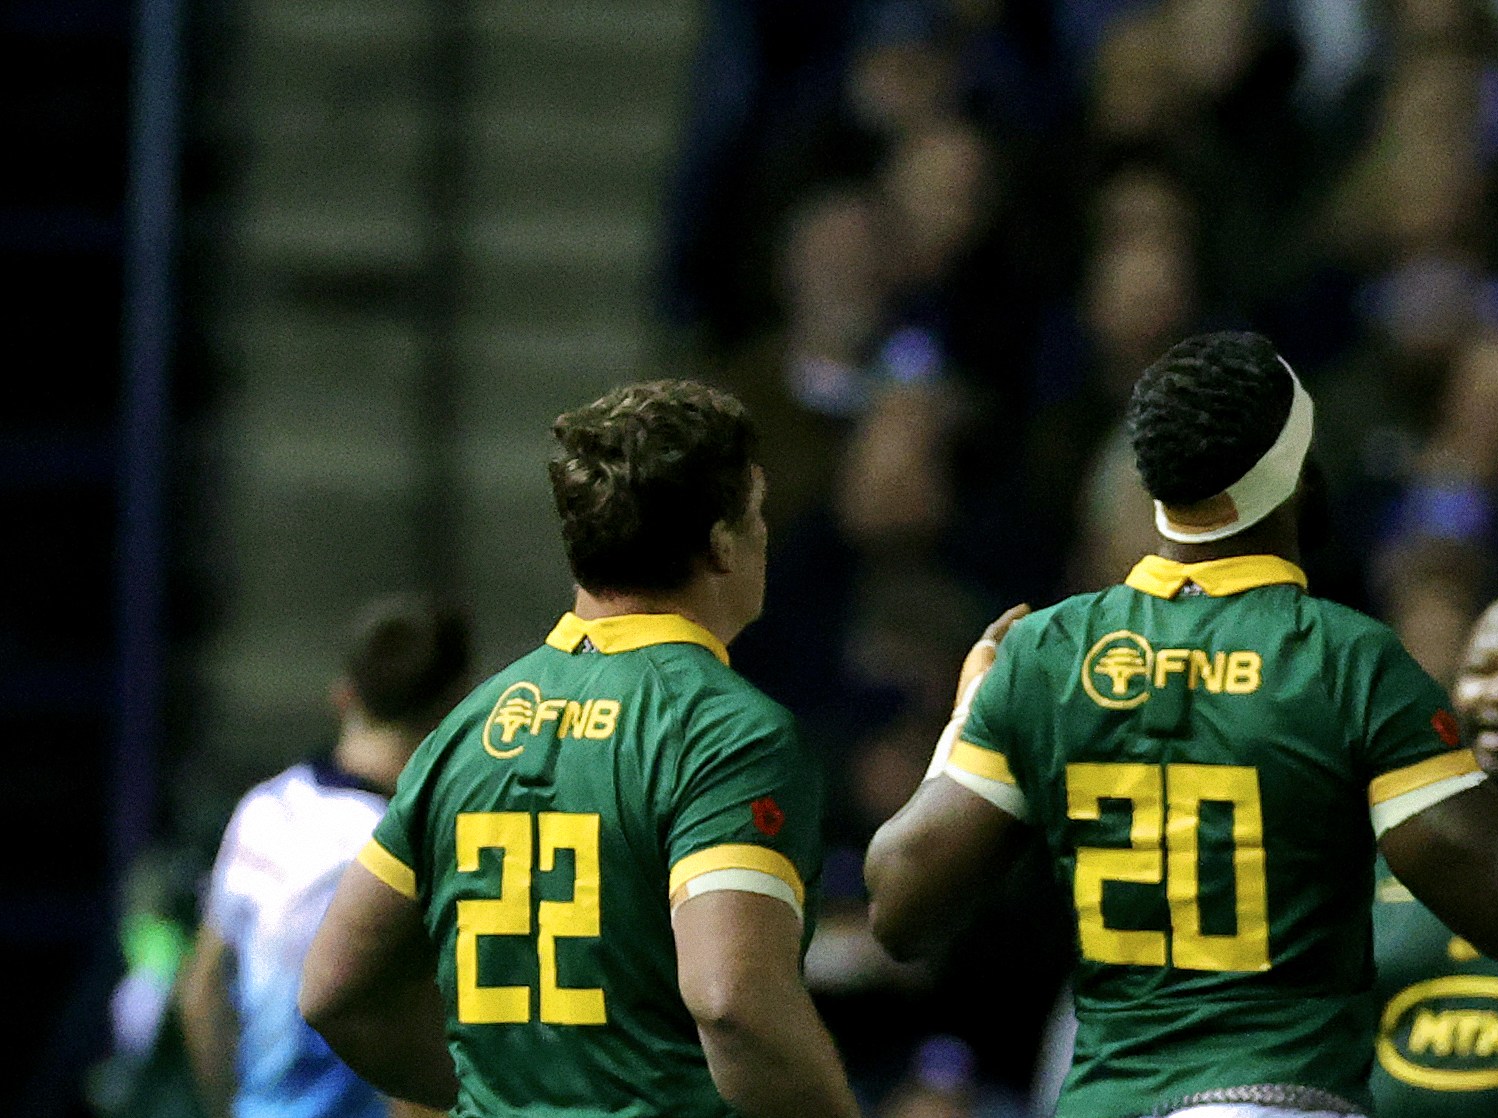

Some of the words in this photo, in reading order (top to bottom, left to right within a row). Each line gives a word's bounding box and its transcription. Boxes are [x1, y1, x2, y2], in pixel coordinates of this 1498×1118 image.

[529, 697, 621, 740] FNB
[1151, 647, 1263, 694] FNB
[455, 811, 608, 1026] 22
[1065, 762, 1272, 972] 20
